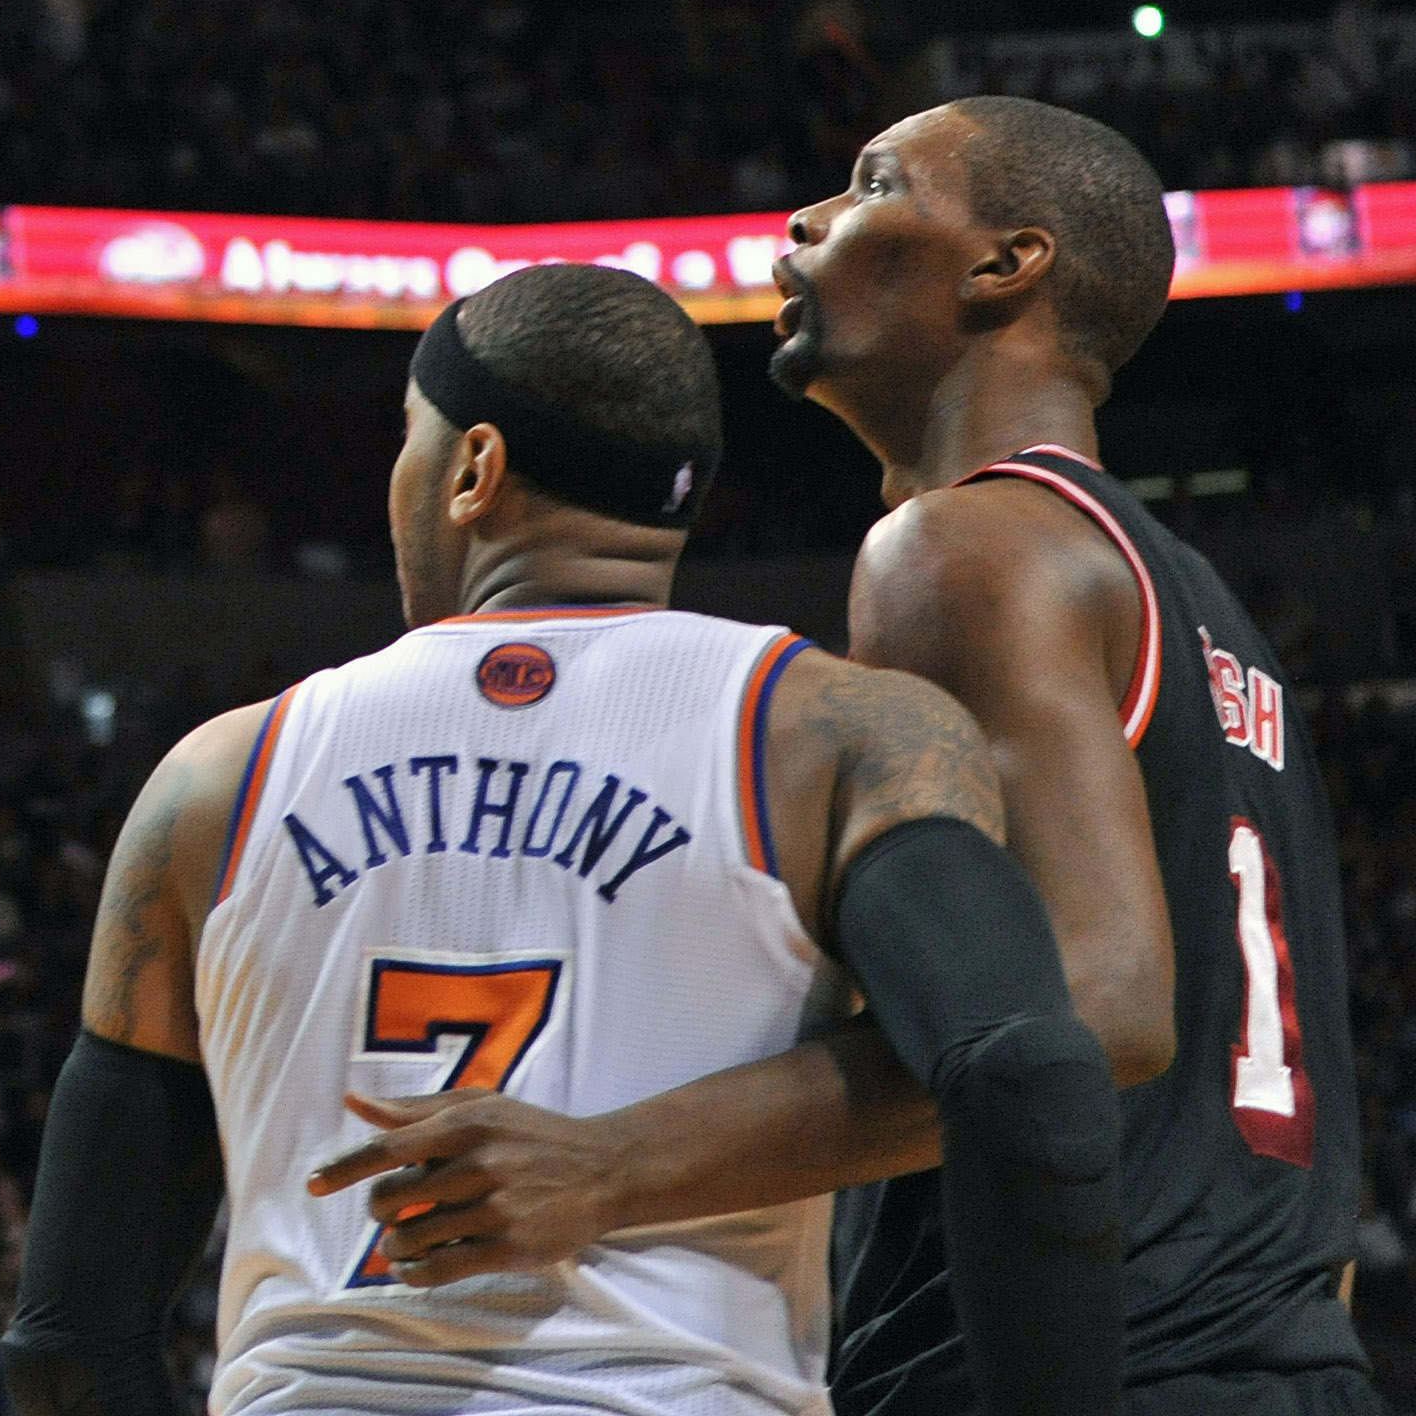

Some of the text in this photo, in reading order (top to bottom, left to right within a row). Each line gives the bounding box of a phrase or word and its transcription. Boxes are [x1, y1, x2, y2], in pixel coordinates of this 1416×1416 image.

[283, 754, 691, 909] ANTHONY
[1227, 820, 1304, 1139] 1
[348, 954, 565, 1290] 7
